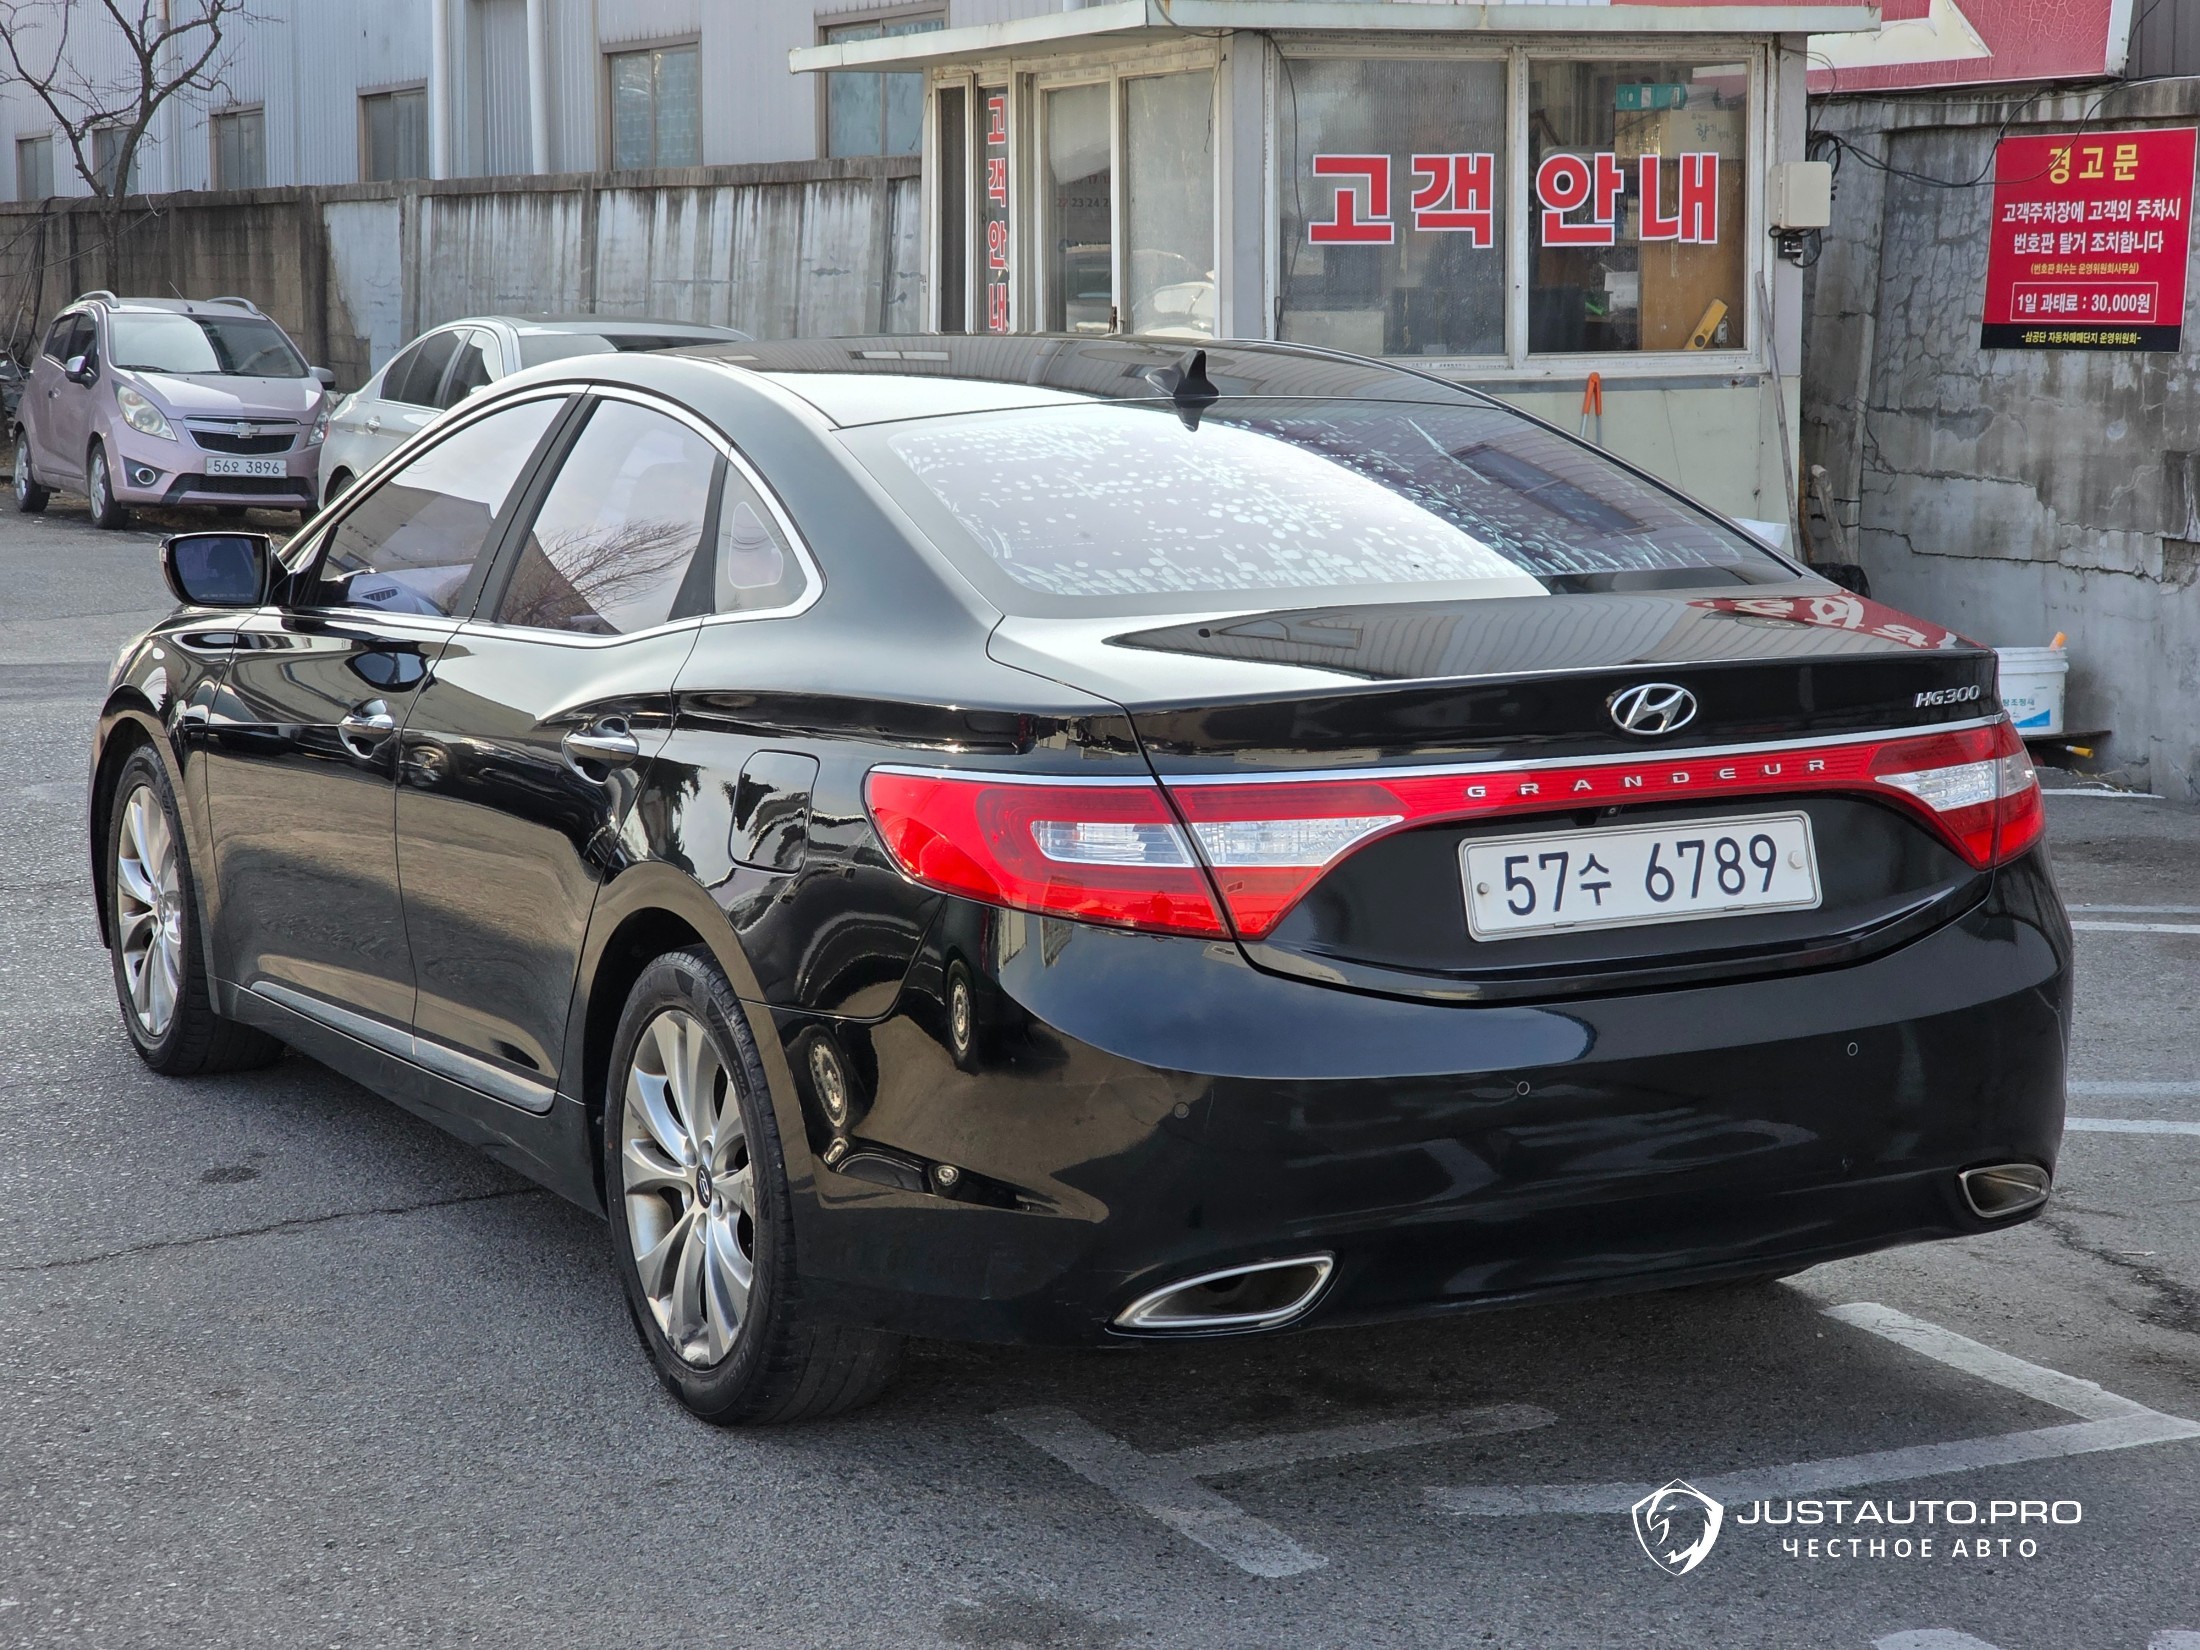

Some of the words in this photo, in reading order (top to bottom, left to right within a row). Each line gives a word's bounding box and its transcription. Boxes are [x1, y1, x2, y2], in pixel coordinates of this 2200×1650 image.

[2048, 144, 2138, 184] 경고문
[1308, 153, 1495, 248] 고객
[1536, 152, 1719, 246] 안내
[2002, 201, 2085, 224] 고객주차장에
[2088, 199, 2132, 221] 고객외
[2136, 198, 2181, 221] 주차시
[2014, 232, 2054, 254] 번호판
[2059, 232, 2086, 254] 탈거
[2090, 230, 2164, 253] 조치합니다
[2017, 293, 2037, 313] 1일
[2040, 293, 2078, 313] 과태료
[2091, 293, 2150, 314] 30,000원
[246, 461, 280, 474] 3896
[1915, 684, 1981, 708] HG300
[1467, 759, 1826, 798] GRANDEUR
[1504, 850, 1613, 917] 57수
[1645, 833, 1778, 904] 6789
